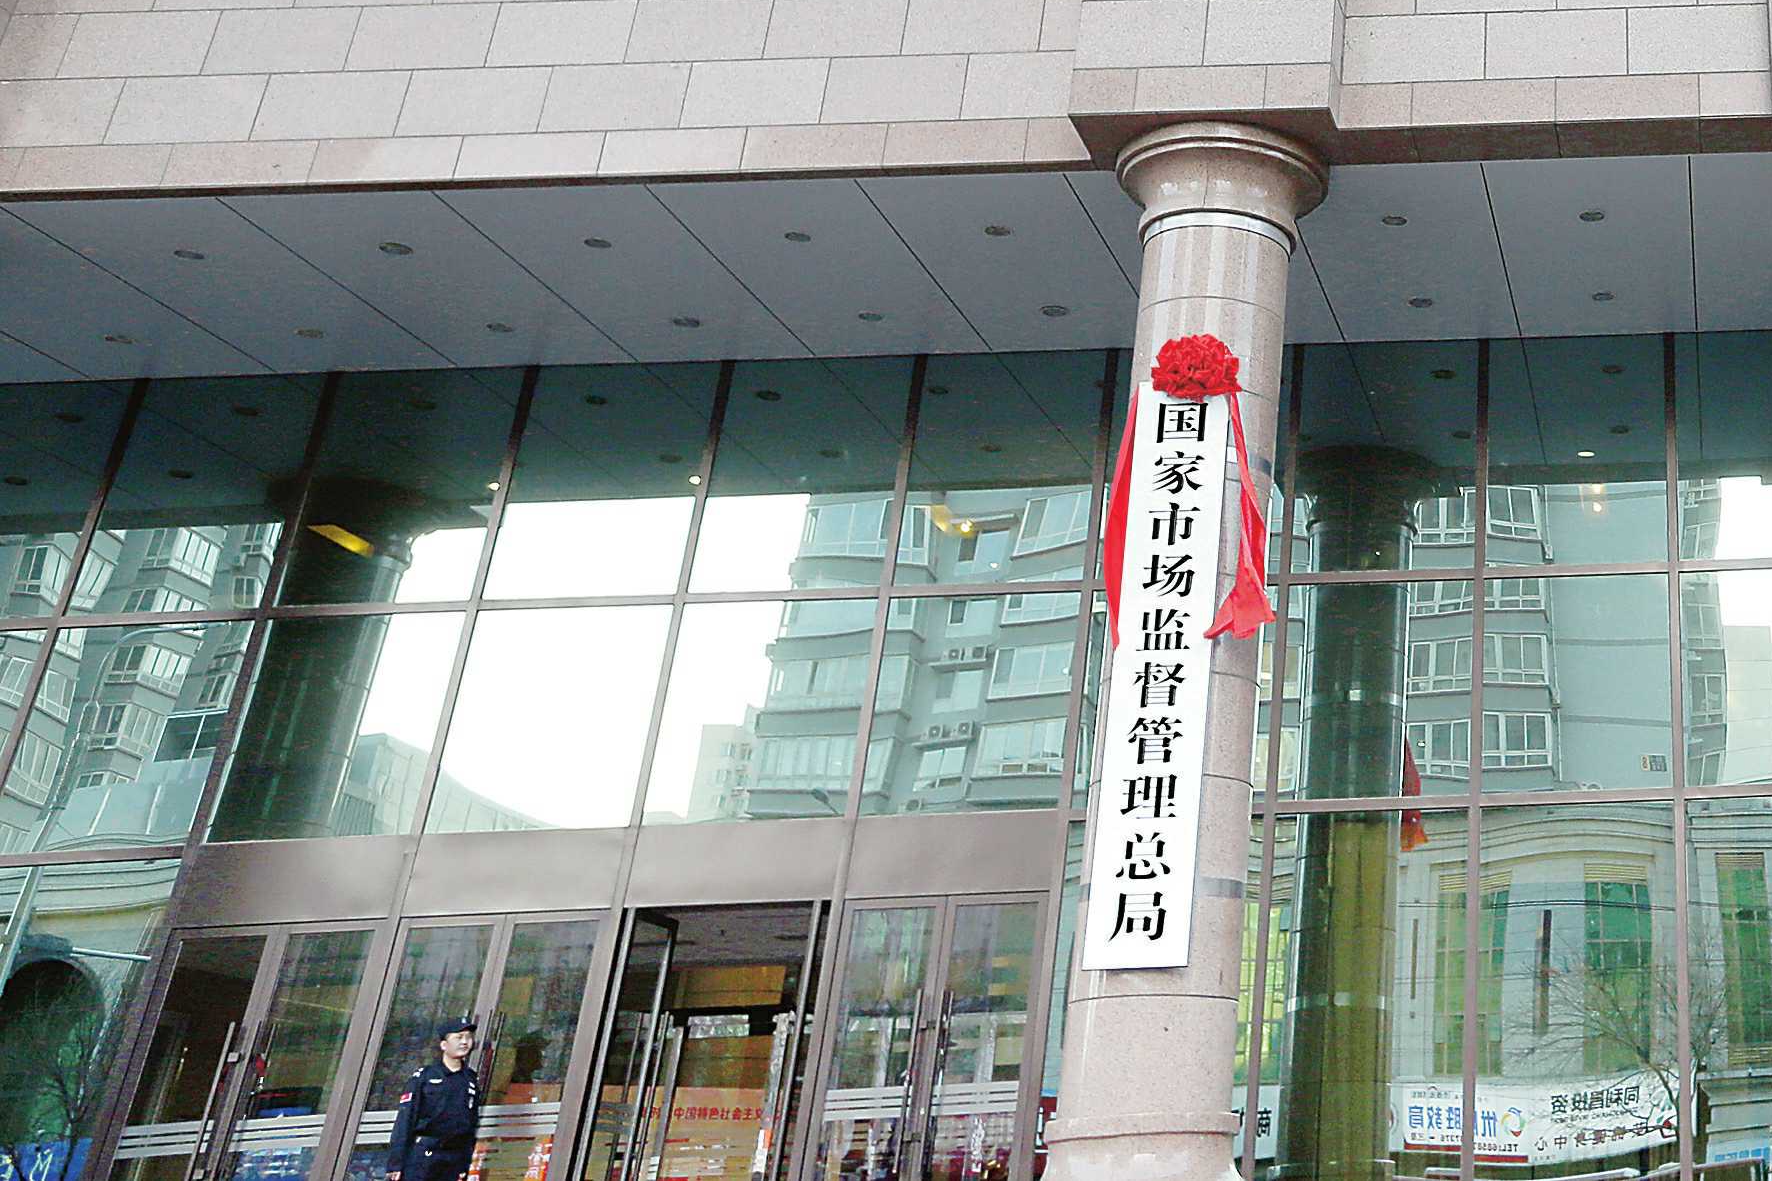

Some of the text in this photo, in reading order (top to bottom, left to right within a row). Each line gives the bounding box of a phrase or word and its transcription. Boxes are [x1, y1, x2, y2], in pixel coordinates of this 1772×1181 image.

[1109, 400, 1209, 942] 国家市场监督管理总局
